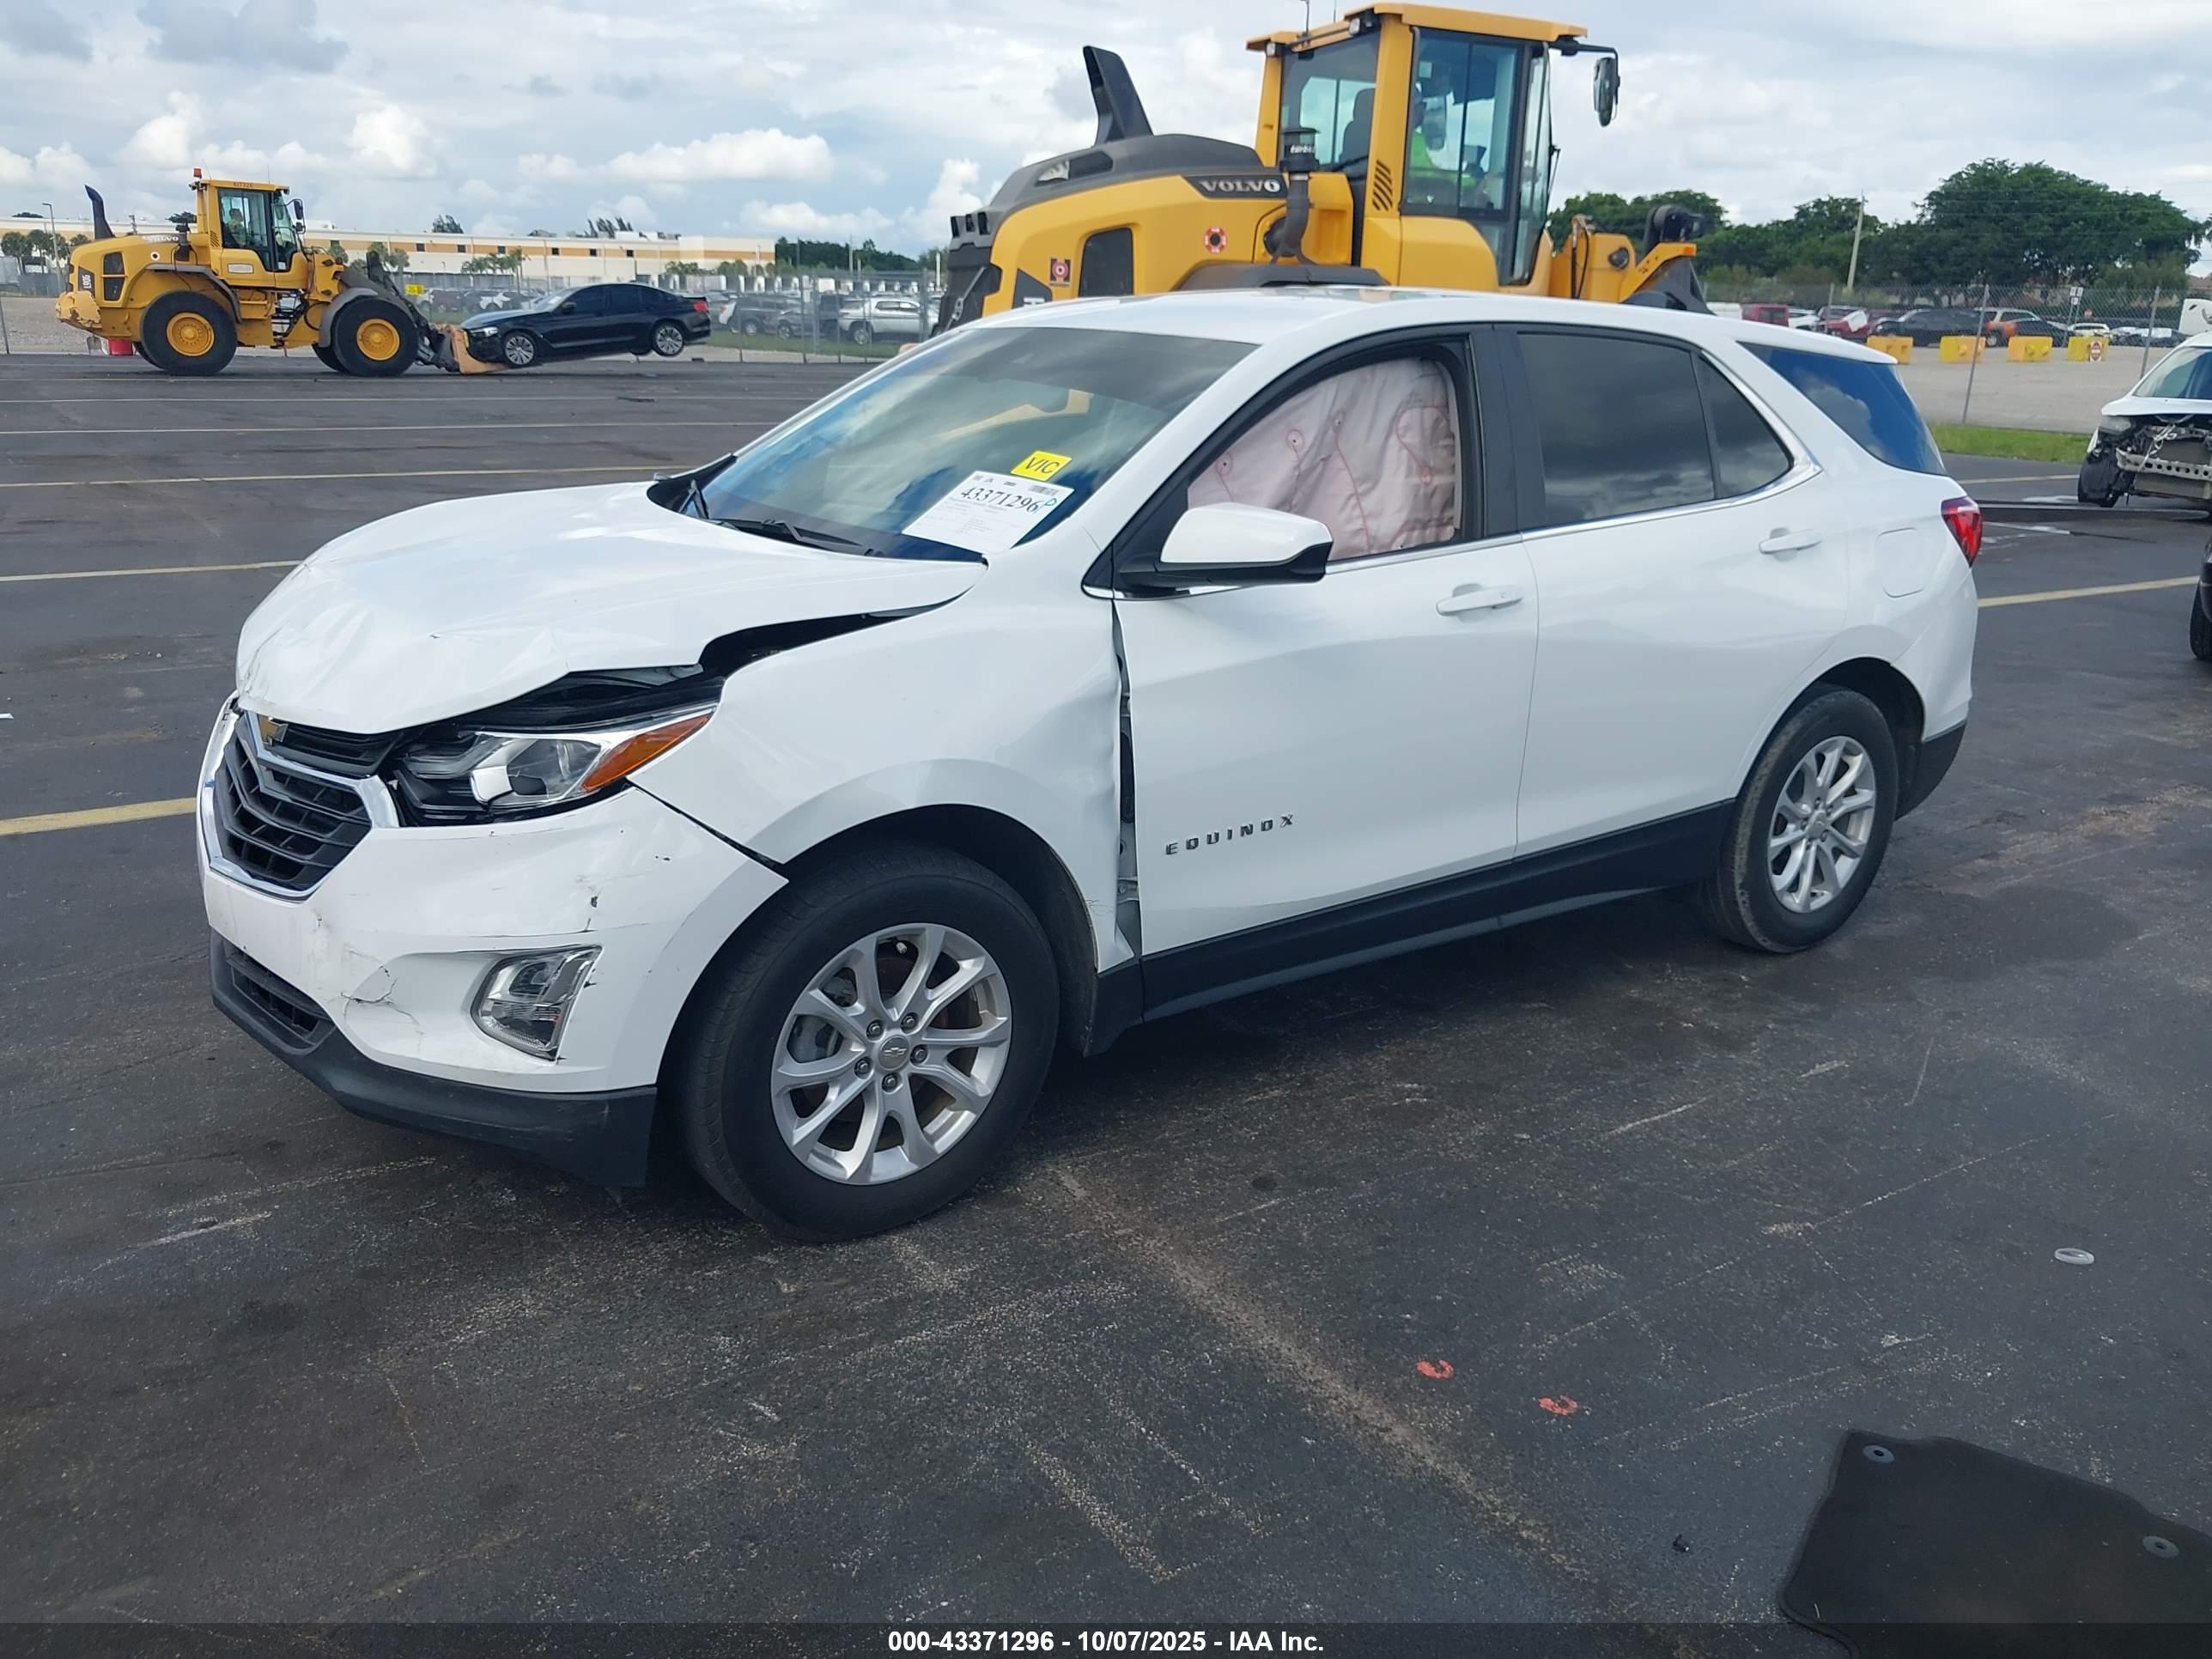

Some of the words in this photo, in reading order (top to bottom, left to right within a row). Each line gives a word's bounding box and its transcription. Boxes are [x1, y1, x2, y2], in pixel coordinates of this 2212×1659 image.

[1200, 179, 1280, 192] VOLVO
[1024, 457, 1060, 474] VIC
[960, 487, 1042, 514] 43371296
[1165, 814, 1294, 855] EQUINOX
